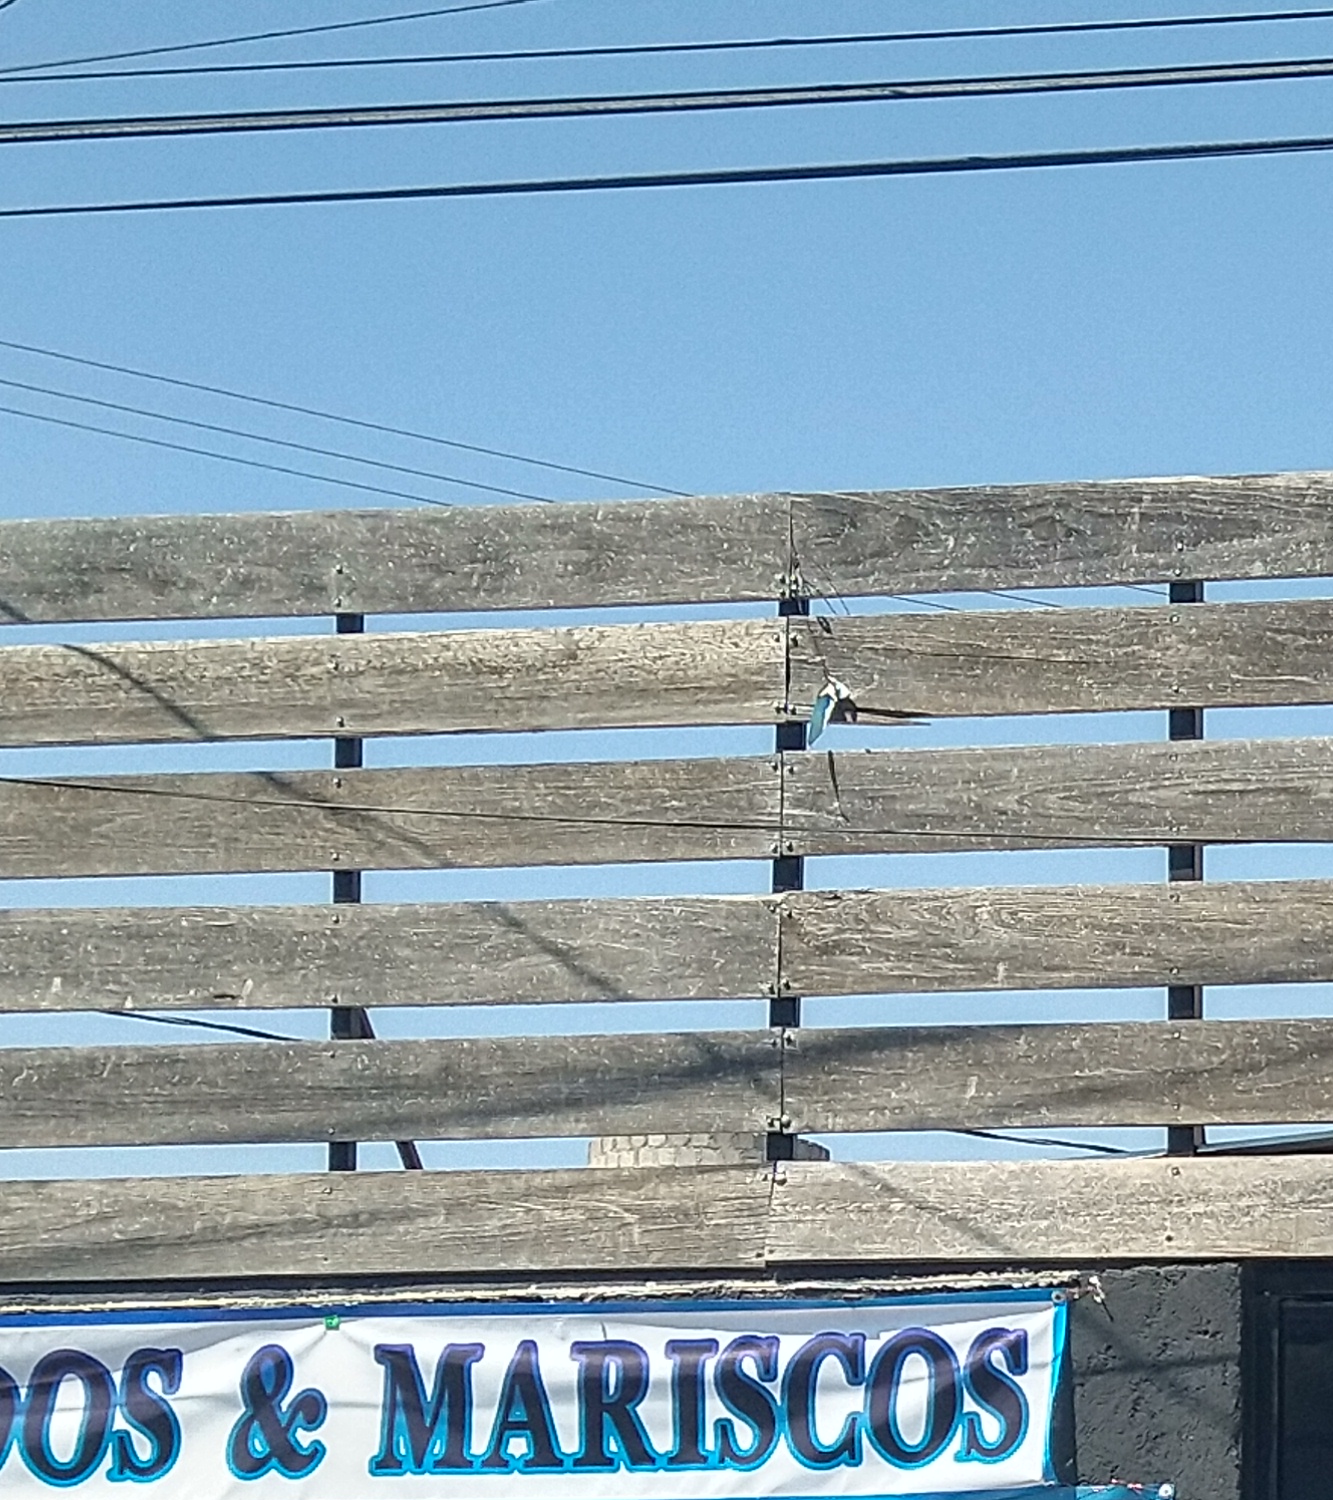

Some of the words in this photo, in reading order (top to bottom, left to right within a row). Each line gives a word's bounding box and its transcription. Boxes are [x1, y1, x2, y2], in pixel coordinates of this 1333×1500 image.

[0, 1347, 183, 1488] OS
[225, 1343, 328, 1481] &
[367, 1326, 1030, 1475] MARISCOS
